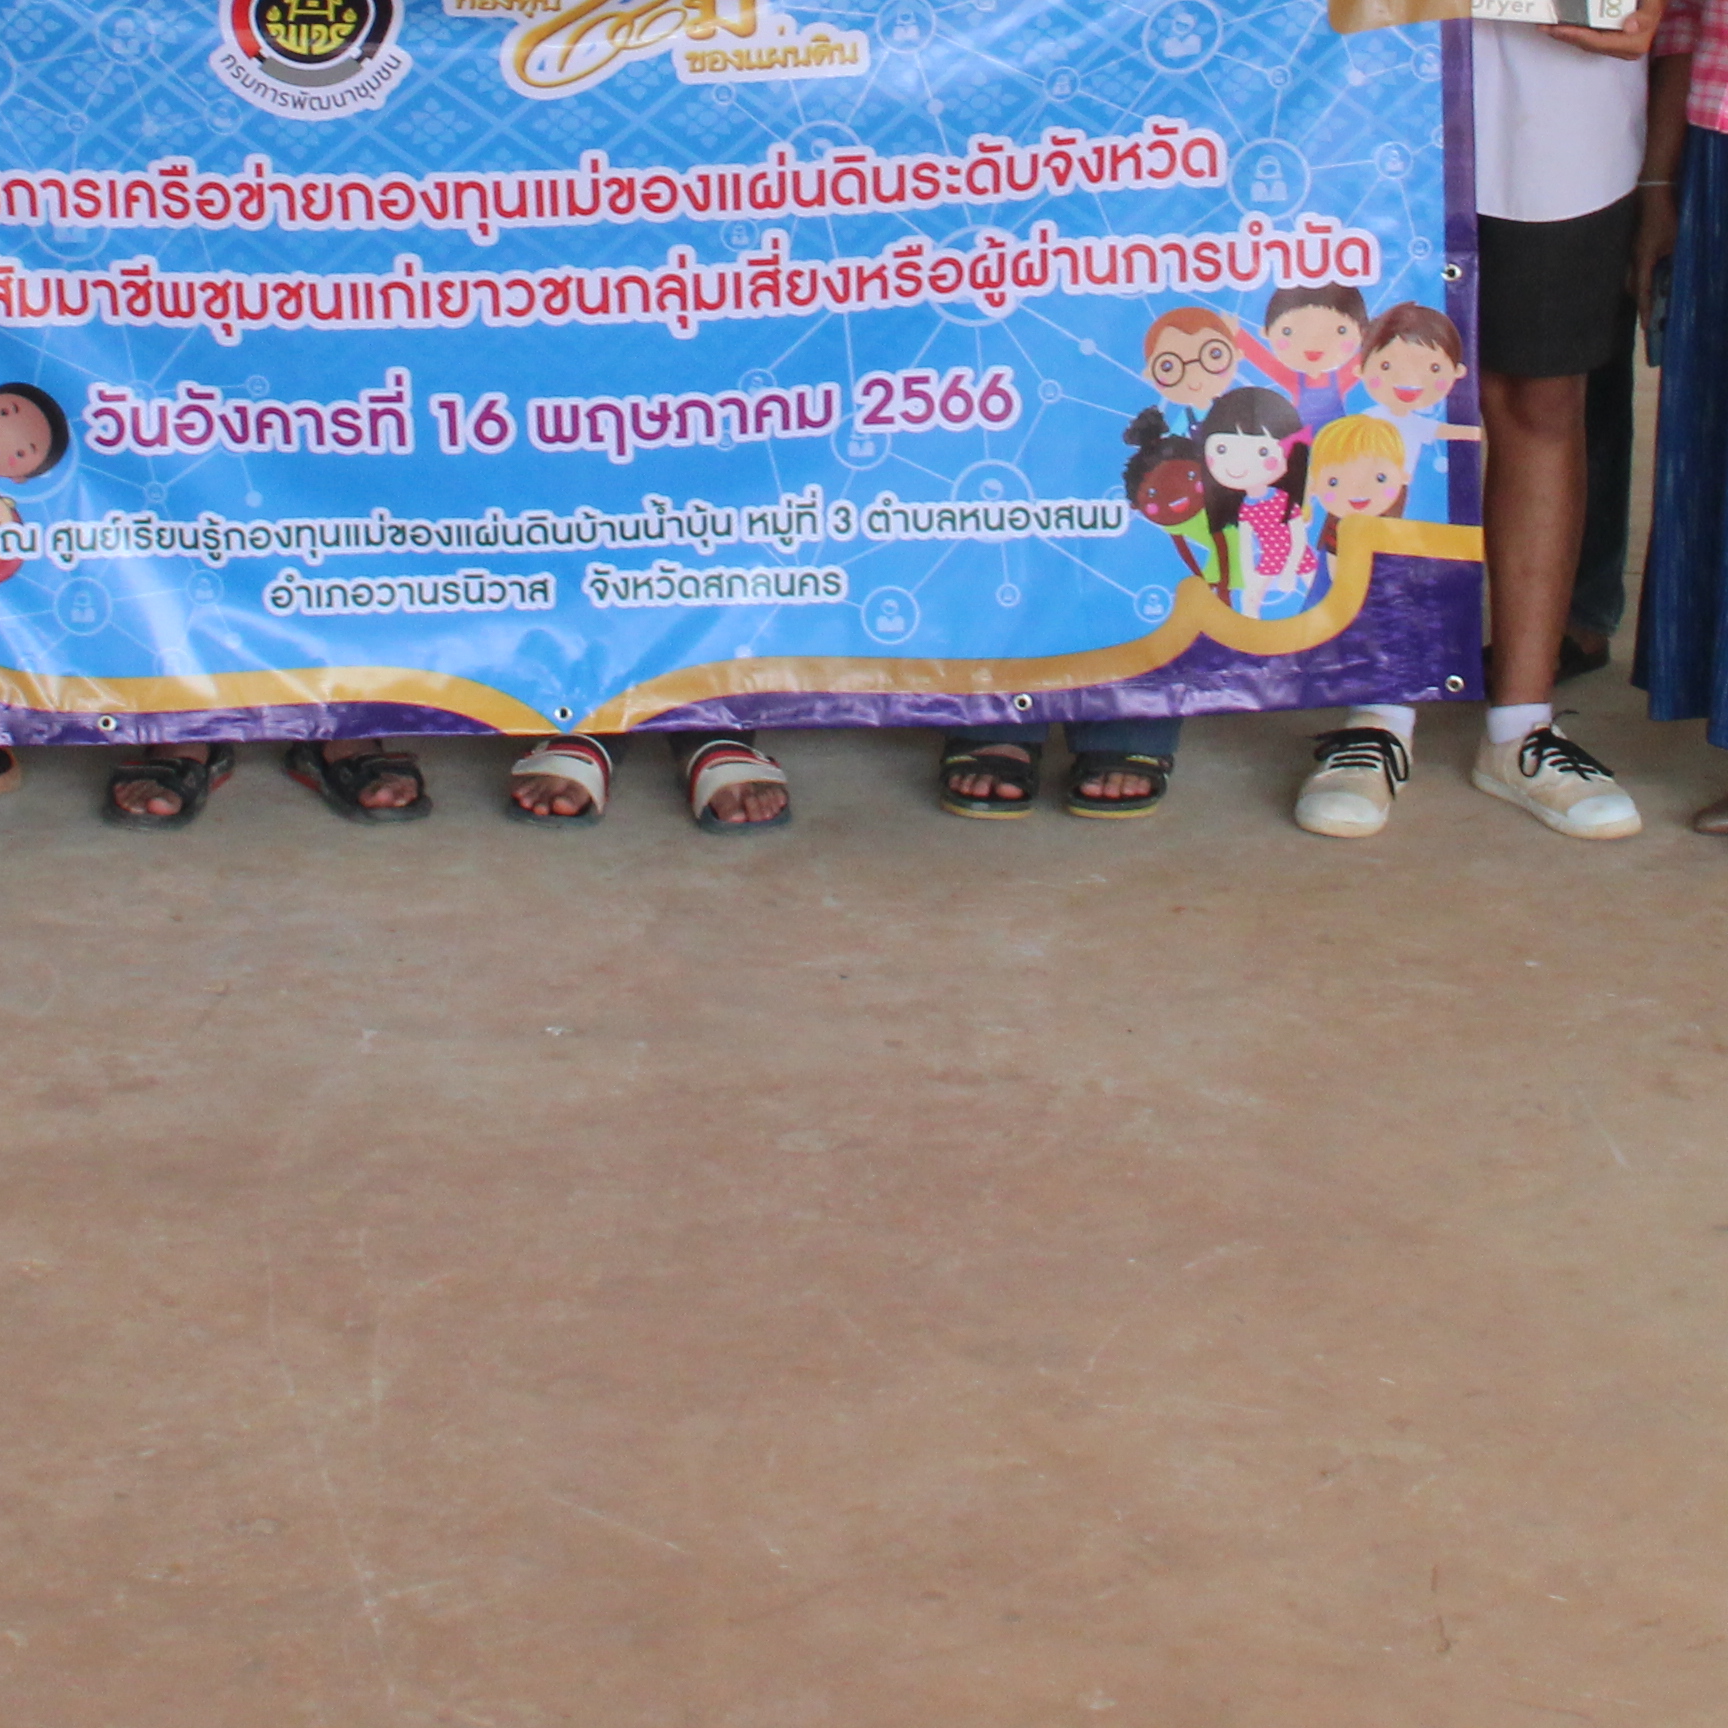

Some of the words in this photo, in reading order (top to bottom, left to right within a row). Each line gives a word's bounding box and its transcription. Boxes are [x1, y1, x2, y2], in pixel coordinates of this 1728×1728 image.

[685, 26, 860, 74] ของแผ่นดิน
[220, 52, 403, 113] กรมการพัฒนาชุมชน
[91, 371, 409, 450] วันอังคารที่
[439, 398, 509, 449] 16
[536, 383, 833, 456] พฤษภาคม
[863, 376, 1014, 429] 2566
[0, 529, 37, 553] ณ
[747, 491, 818, 547] หมู่ที่
[832, 506, 852, 534] 3
[867, 496, 1123, 536] ตำบลหนองสนม
[271, 574, 550, 609] อำเภอวานรนิวาส
[590, 567, 841, 601] จังหวัดสกลนคร
